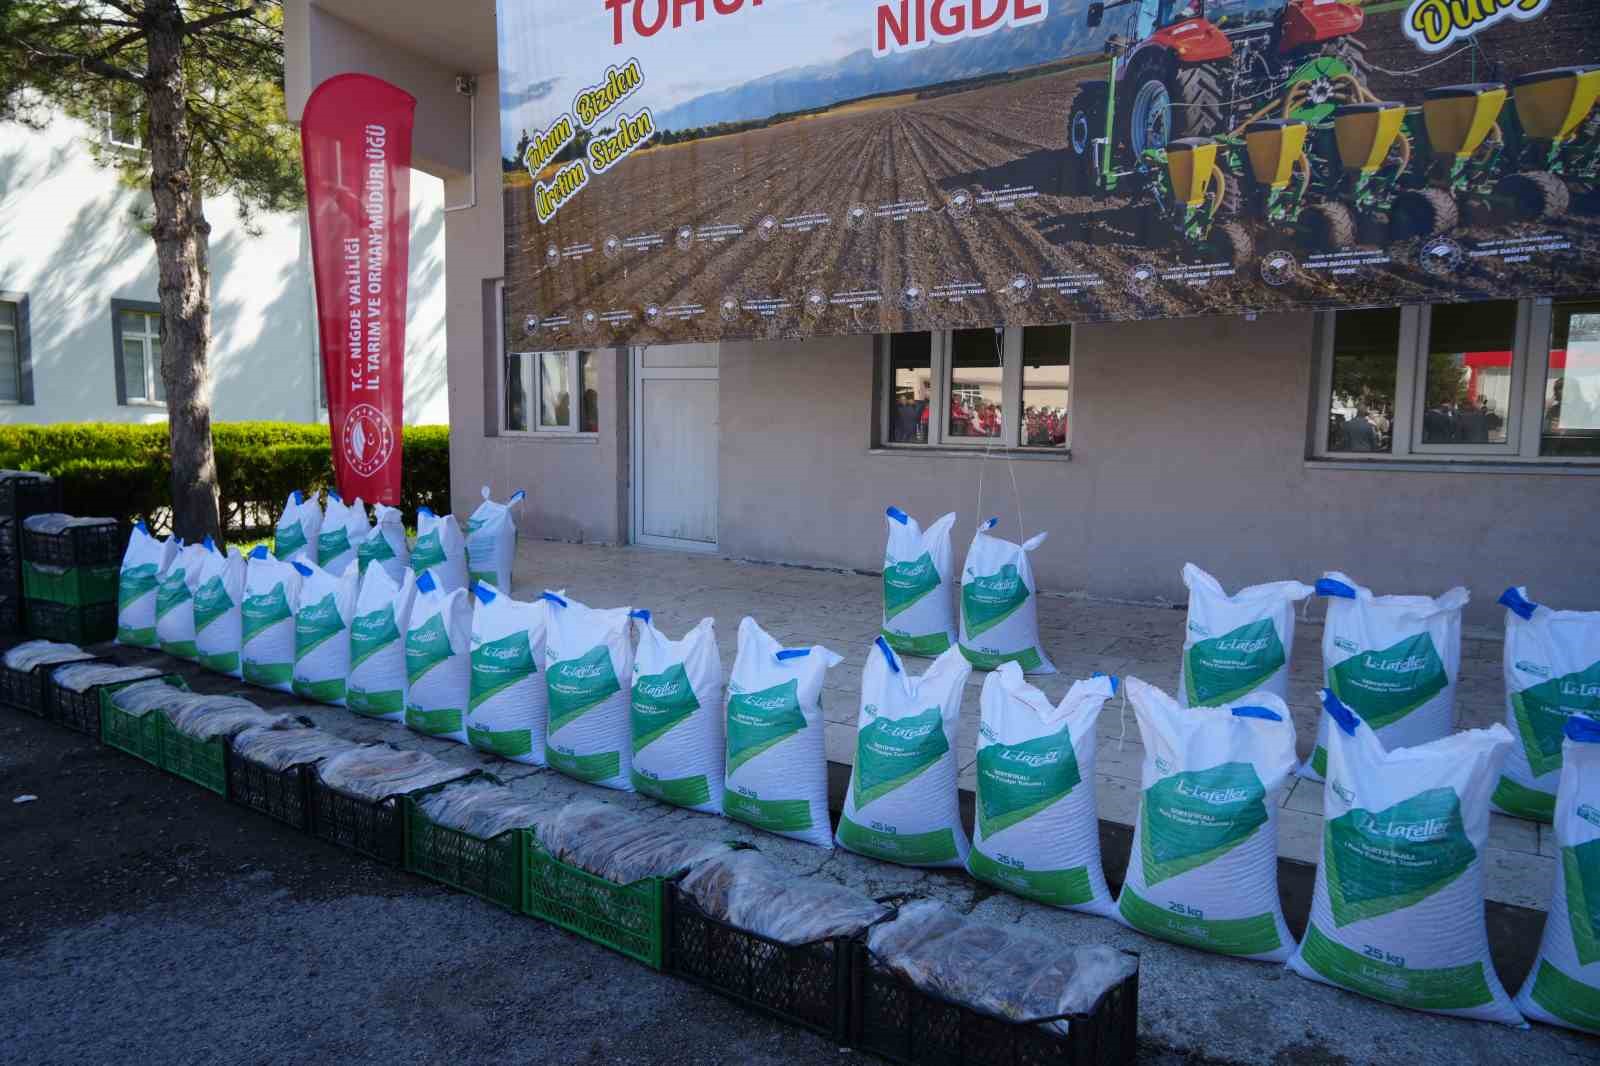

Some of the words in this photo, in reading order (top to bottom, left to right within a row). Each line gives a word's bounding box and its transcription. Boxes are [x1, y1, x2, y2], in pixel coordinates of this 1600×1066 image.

[526, 118, 573, 173] Tohum
[576, 63, 641, 125] Bizden
[536, 161, 586, 220] Üretim
[589, 112, 651, 170] Sizden
[368, 233, 383, 293] ORMAN
[368, 298, 381, 317] VE
[368, 320, 381, 371] TARIM
[1168, 901, 1185, 914] 25
[1187, 904, 1203, 919] kg
[1364, 944, 1383, 960] 25
[1386, 951, 1405, 968] kg
